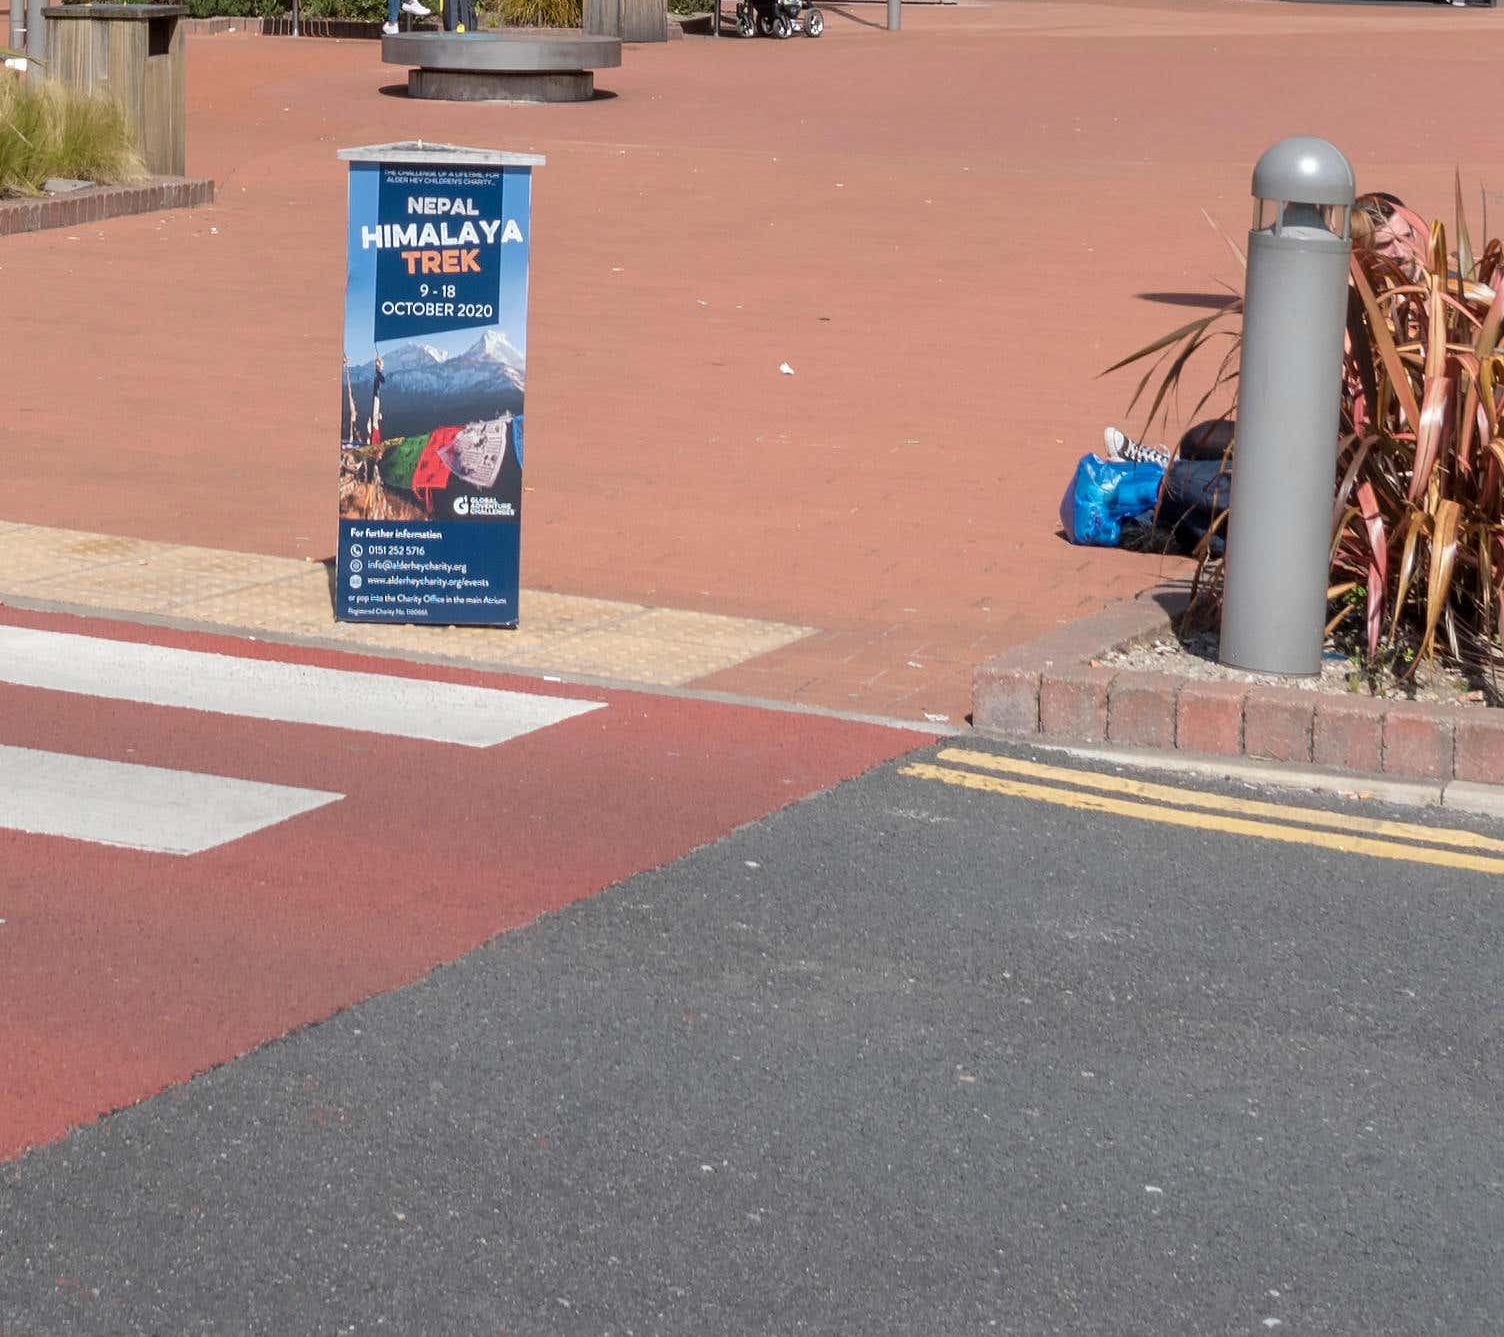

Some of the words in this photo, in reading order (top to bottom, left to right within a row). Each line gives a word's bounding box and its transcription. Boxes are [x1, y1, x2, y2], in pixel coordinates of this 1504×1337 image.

[386, 176, 408, 184] ALDER
[409, 176, 423, 184] HEY
[407, 196, 480, 216] NEPAL
[361, 219, 524, 249] HIMALAYA
[401, 248, 481, 275] TREK
[419, 283, 429, 298] 9
[441, 284, 456, 298] 18
[381, 301, 454, 317] OCTOBER
[457, 303, 493, 318] 2020
[350, 527, 364, 538] For
[365, 527, 394, 538] further
[395, 528, 443, 540] information
[368, 545, 387, 555] 0151
[388, 545, 404, 556] 252
[405, 546, 426, 556] 5716
[367, 559, 467, 574] info@alderheycharity.org
[367, 574, 490, 589] www.alderheycharity.org/events
[397, 593, 422, 605] Charity
